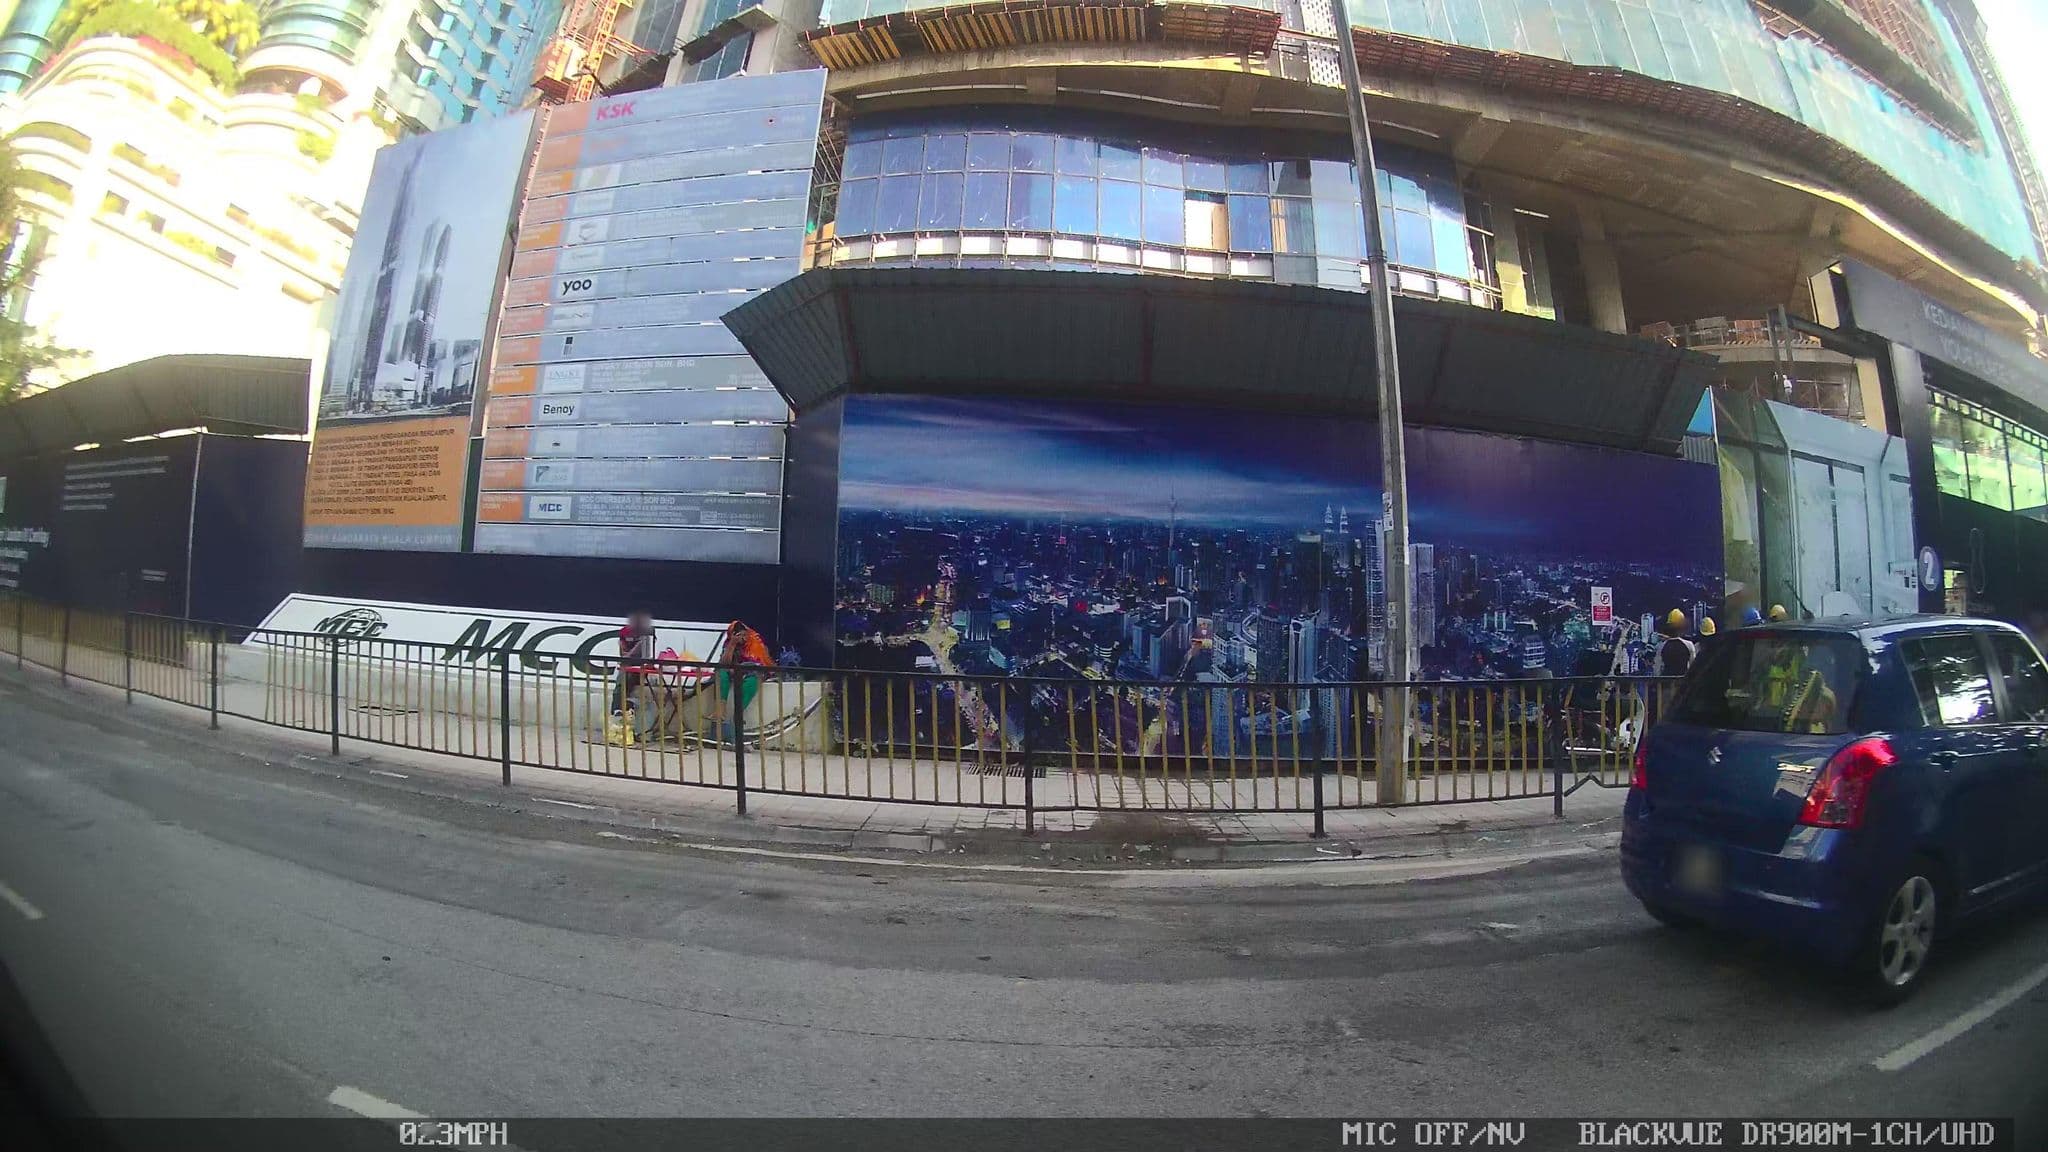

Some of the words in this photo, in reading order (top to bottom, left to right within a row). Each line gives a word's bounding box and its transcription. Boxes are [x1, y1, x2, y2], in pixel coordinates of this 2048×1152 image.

[596, 101, 635, 121] KSK
[563, 279, 593, 296] yoo
[543, 404, 575, 416] Benoy
[1924, 551, 1935, 585] 2
[440, 618, 621, 675] MCC
